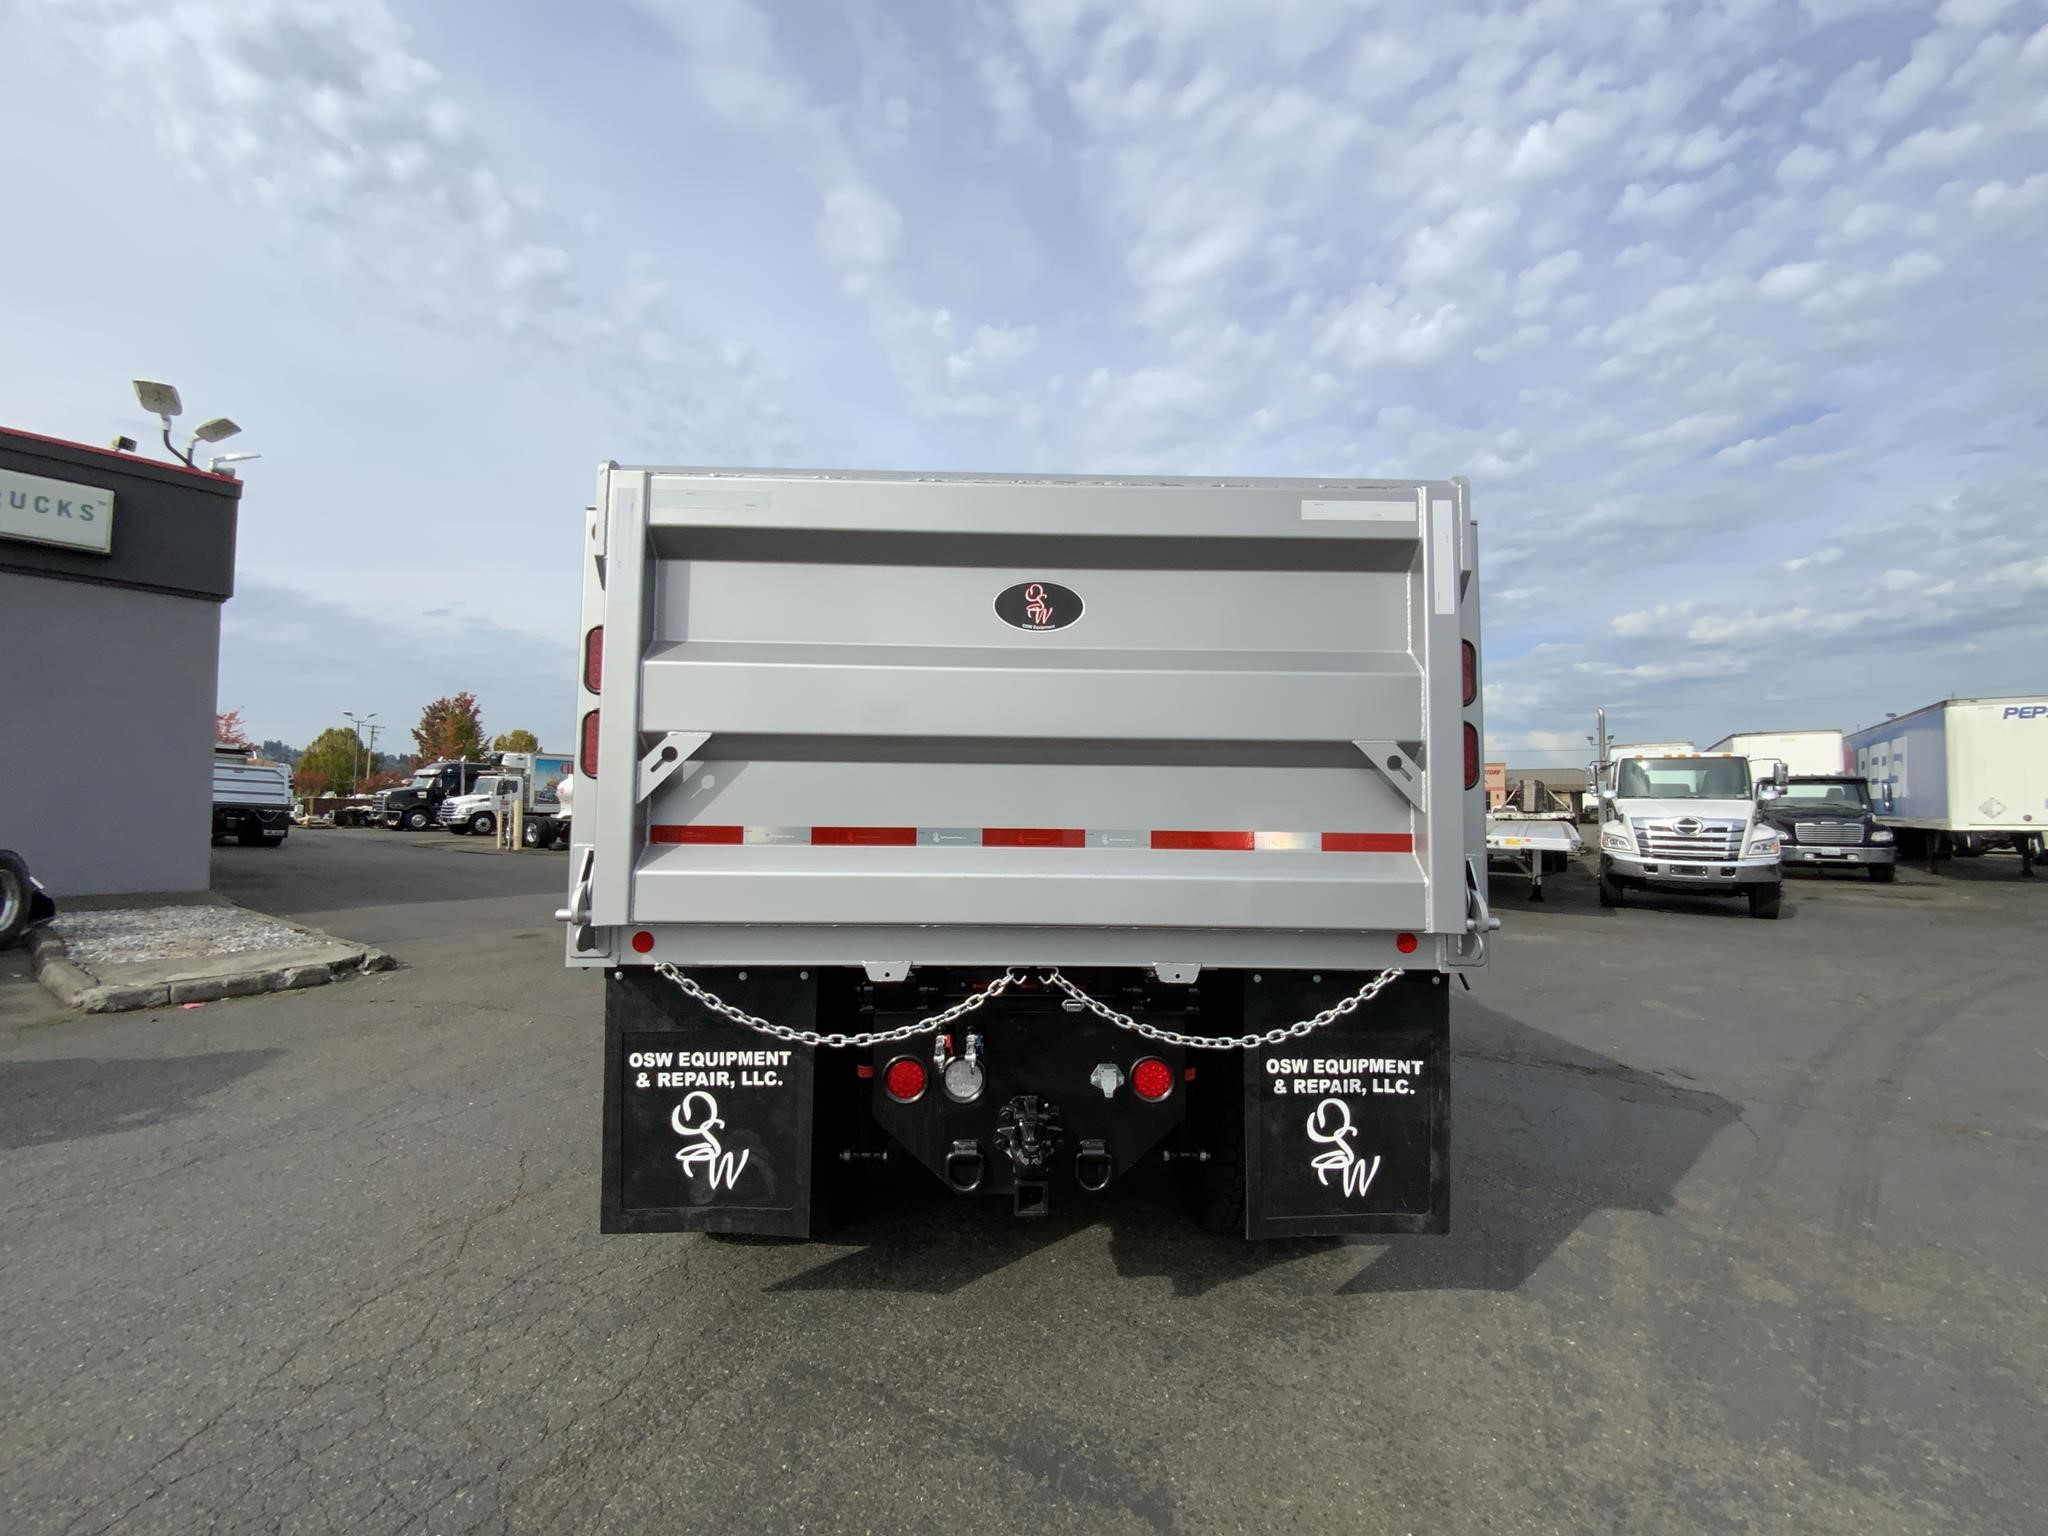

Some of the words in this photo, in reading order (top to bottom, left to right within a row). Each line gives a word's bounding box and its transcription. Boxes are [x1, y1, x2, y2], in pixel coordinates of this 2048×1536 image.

[0, 489, 94, 521] UCKS
[2002, 706, 2048, 720] PEP
[628, 1051, 674, 1068] OSW
[678, 1050, 792, 1068] EQUIPMENT
[1265, 1058, 1309, 1075] OSW
[1312, 1058, 1424, 1076] EQUIPMENT
[635, 1071, 651, 1088] &
[657, 1071, 736, 1090] REPAIR,
[741, 1070, 784, 1087] LLC.
[1273, 1078, 1288, 1095] &
[1293, 1078, 1367, 1097] REPAIR,
[1372, 1078, 1416, 1095] LLC.
